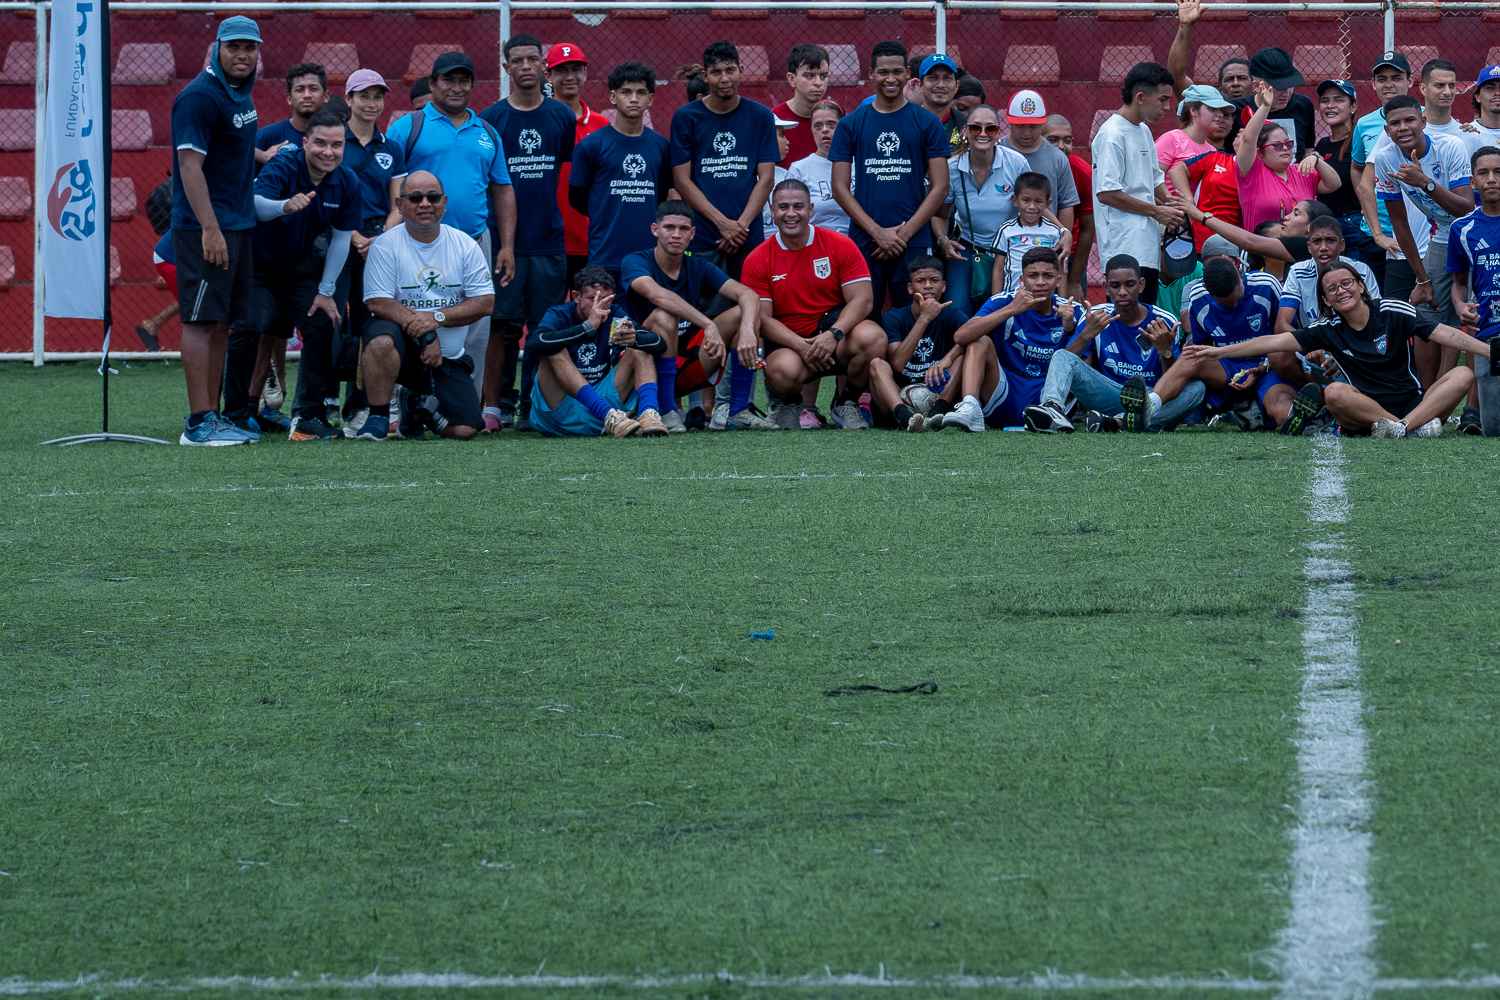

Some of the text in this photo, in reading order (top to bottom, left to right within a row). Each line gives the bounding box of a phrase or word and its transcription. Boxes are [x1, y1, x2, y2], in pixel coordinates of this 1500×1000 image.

[561, 46, 571, 57] P
[508, 154, 556, 165] Olimpiadas
[701, 155, 748, 165] Olimpiadas
[864, 157, 911, 166] Olimpiadas
[509, 163, 555, 173] Especiales
[701, 163, 748, 173] Especiales
[866, 165, 912, 175] Especiales
[713, 171, 738, 179] Panamá
[621, 195, 646, 203] Panamá
[1026, 351, 1053, 360] NACIO
[1027, 346, 1054, 355] BANCO
[1117, 361, 1143, 372] BANCO
[1118, 367, 1156, 377] NACIONAL
